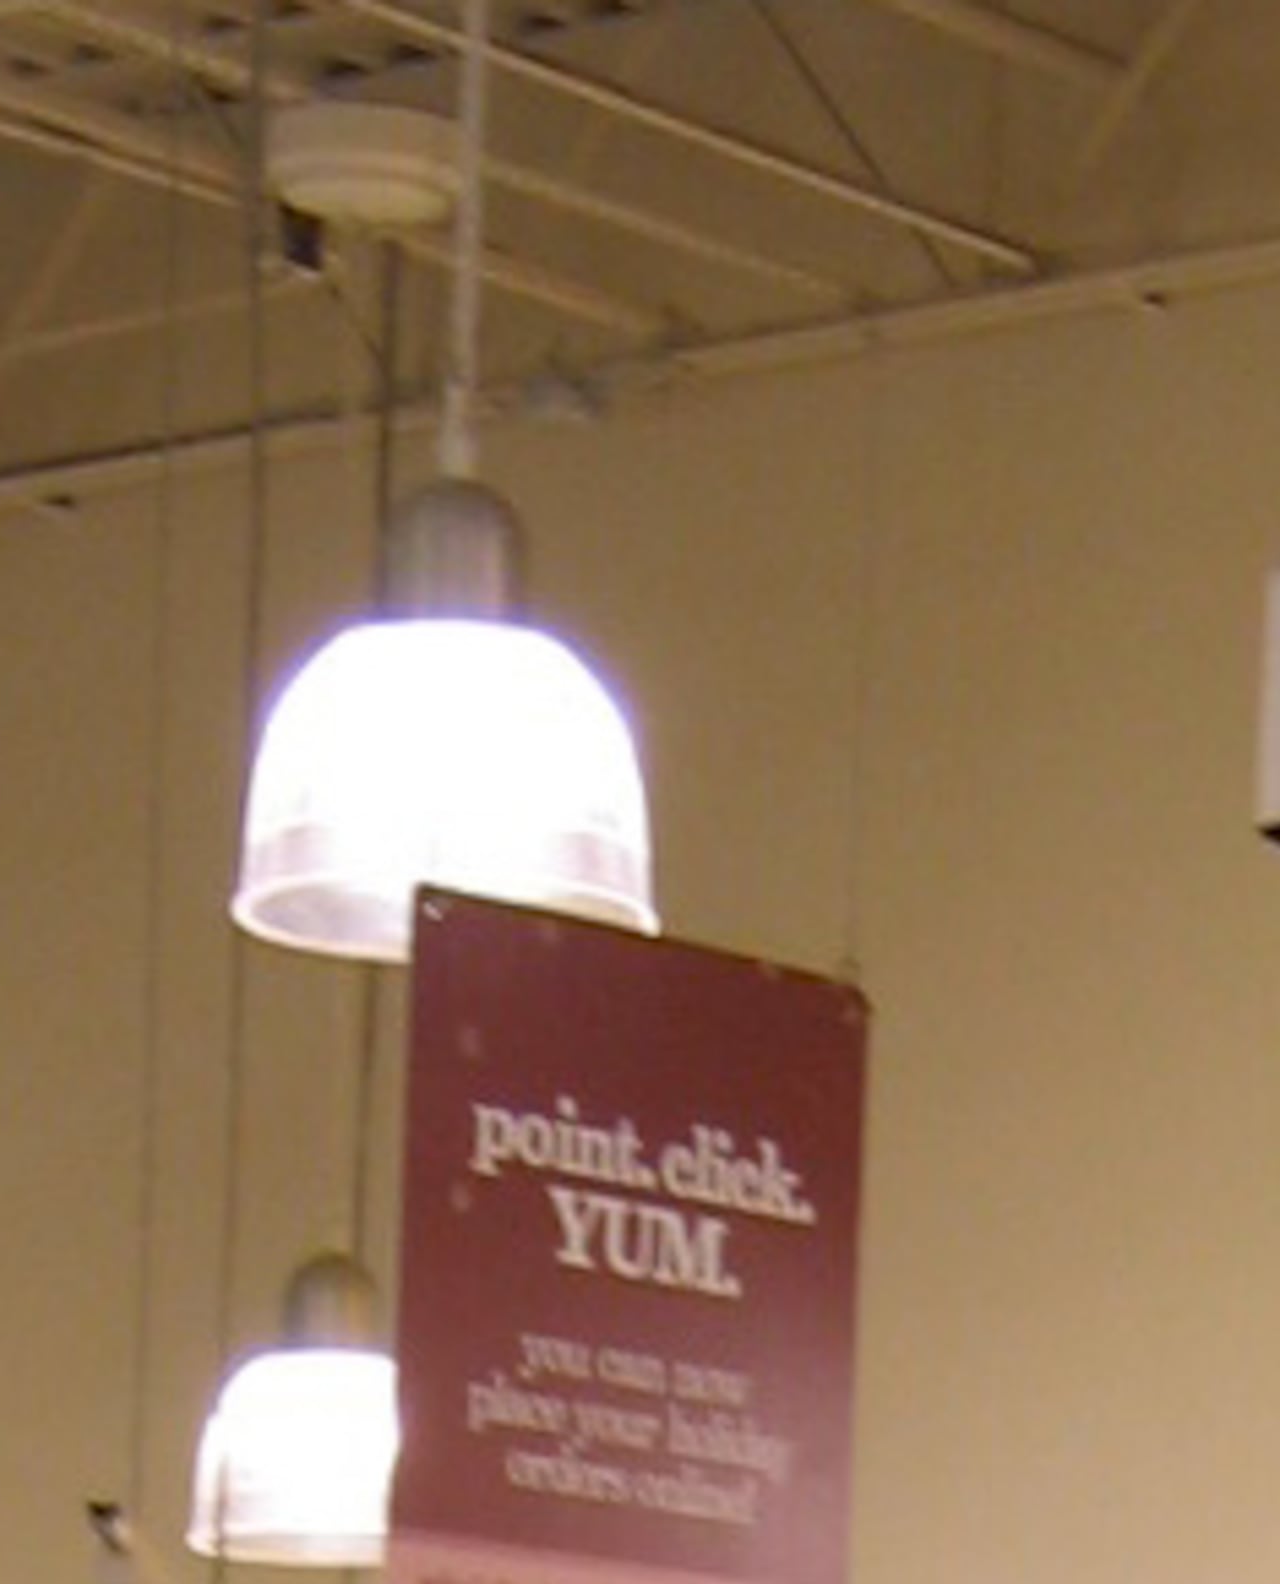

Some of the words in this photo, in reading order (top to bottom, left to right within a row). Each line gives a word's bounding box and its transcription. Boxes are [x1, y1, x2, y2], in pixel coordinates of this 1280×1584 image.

[470, 1094, 655, 1188] point.
[661, 1123, 815, 1225] click.
[547, 1186, 742, 1298] YUM.
